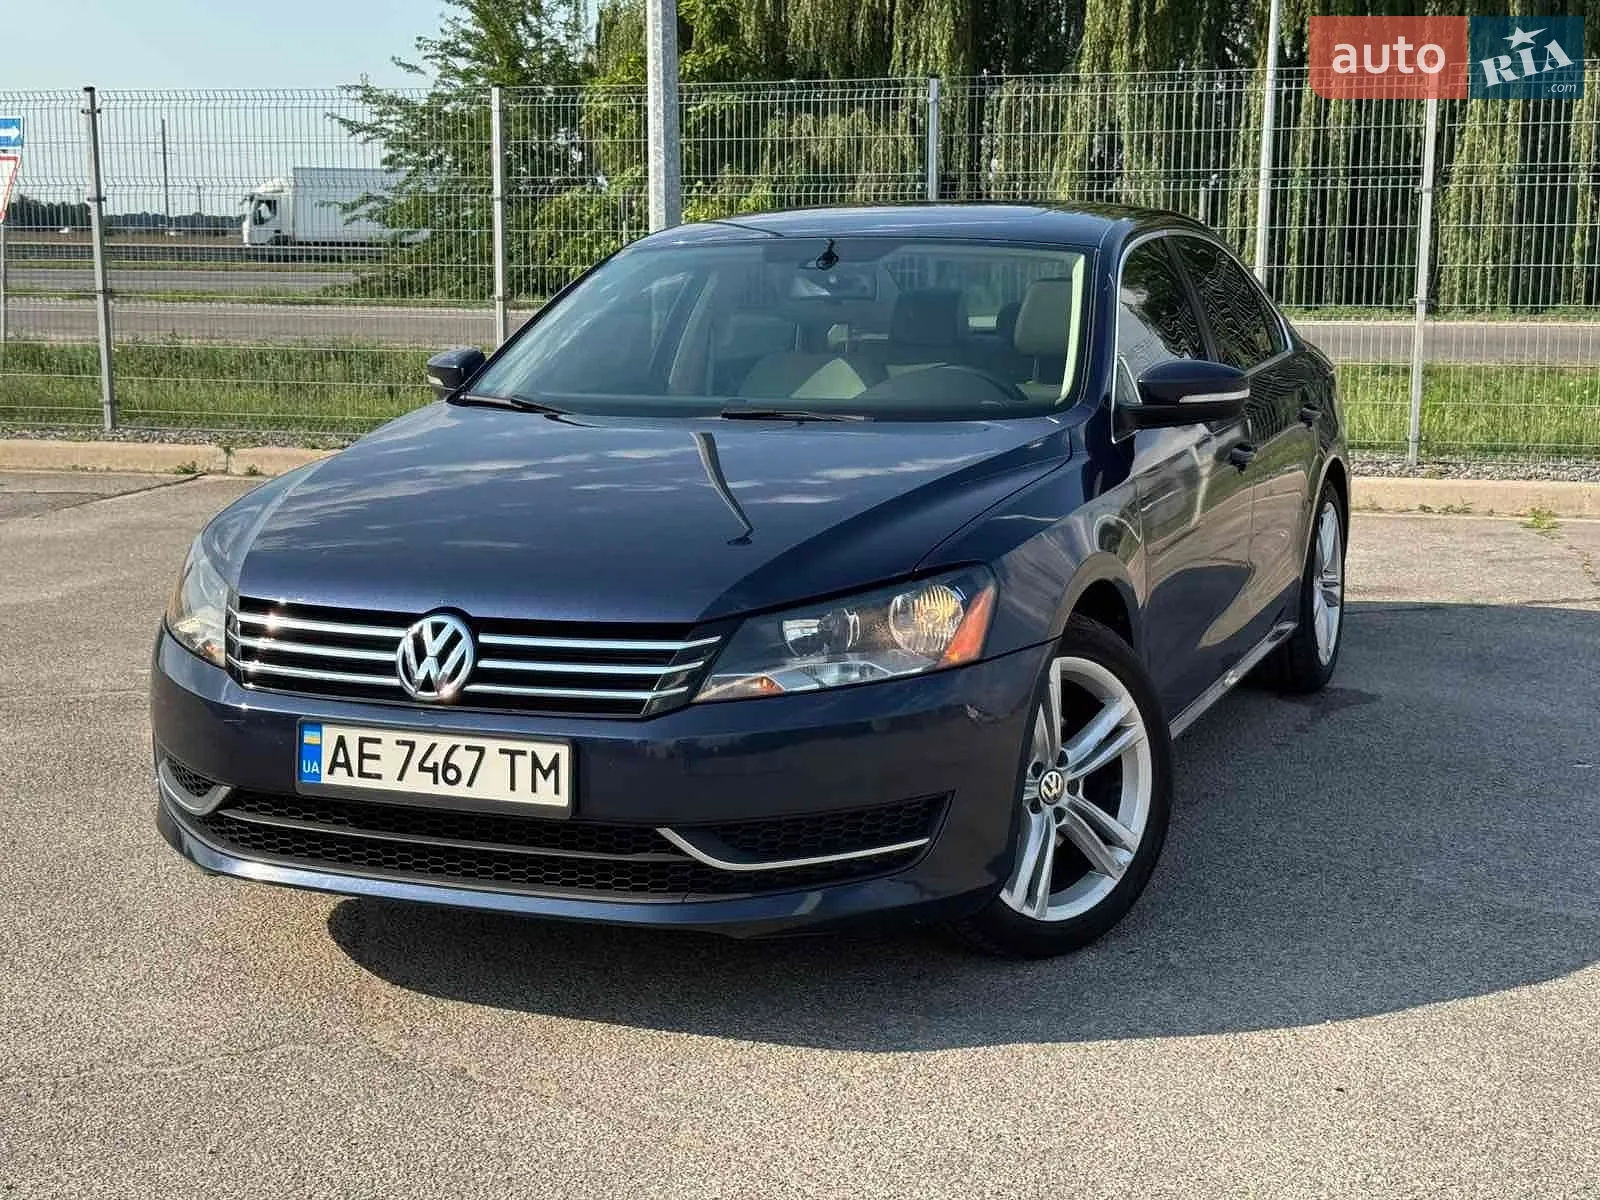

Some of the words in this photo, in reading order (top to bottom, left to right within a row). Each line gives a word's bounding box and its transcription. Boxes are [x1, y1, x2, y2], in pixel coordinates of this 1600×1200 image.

[302, 759, 320, 774] UA
[327, 734, 383, 780] AE
[395, 739, 486, 787] 7467
[498, 748, 560, 796] TM
